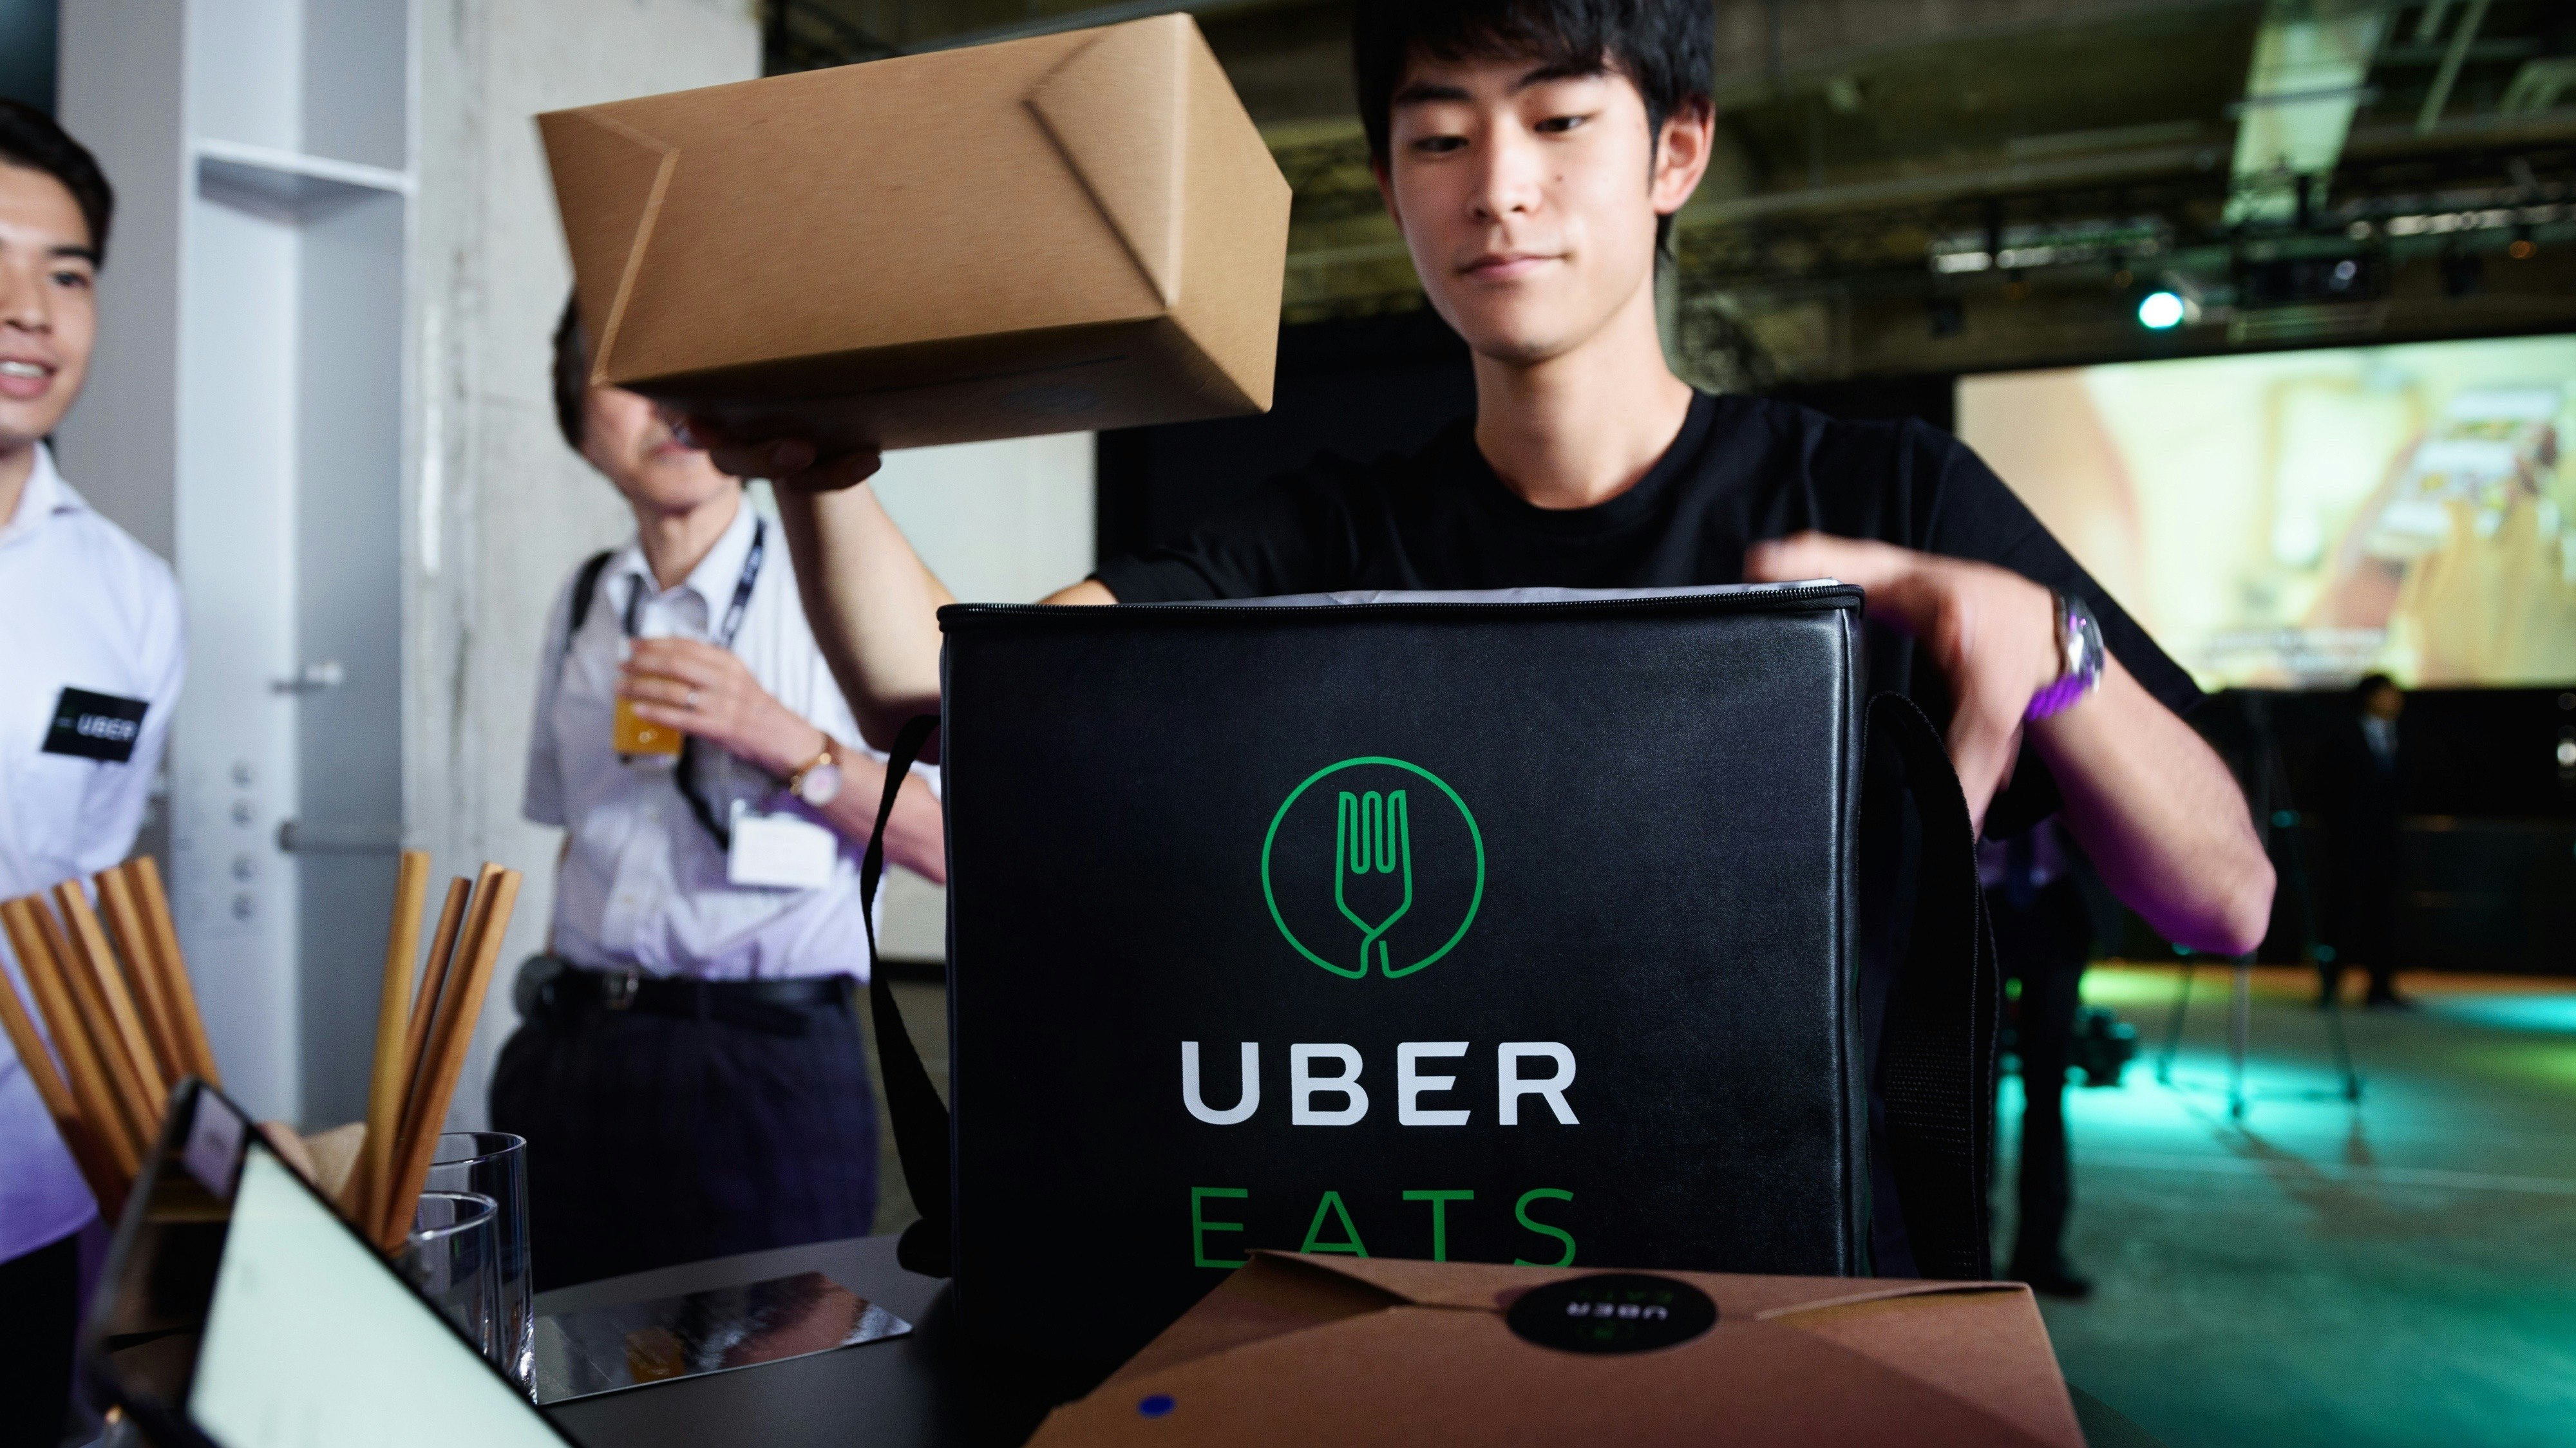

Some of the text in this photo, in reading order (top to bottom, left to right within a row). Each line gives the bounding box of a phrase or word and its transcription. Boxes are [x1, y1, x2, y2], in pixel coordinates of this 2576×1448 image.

[77, 713, 138, 741] UBER
[1181, 1040, 1580, 1126] UBER
[1191, 1186, 1576, 1268] EATS
